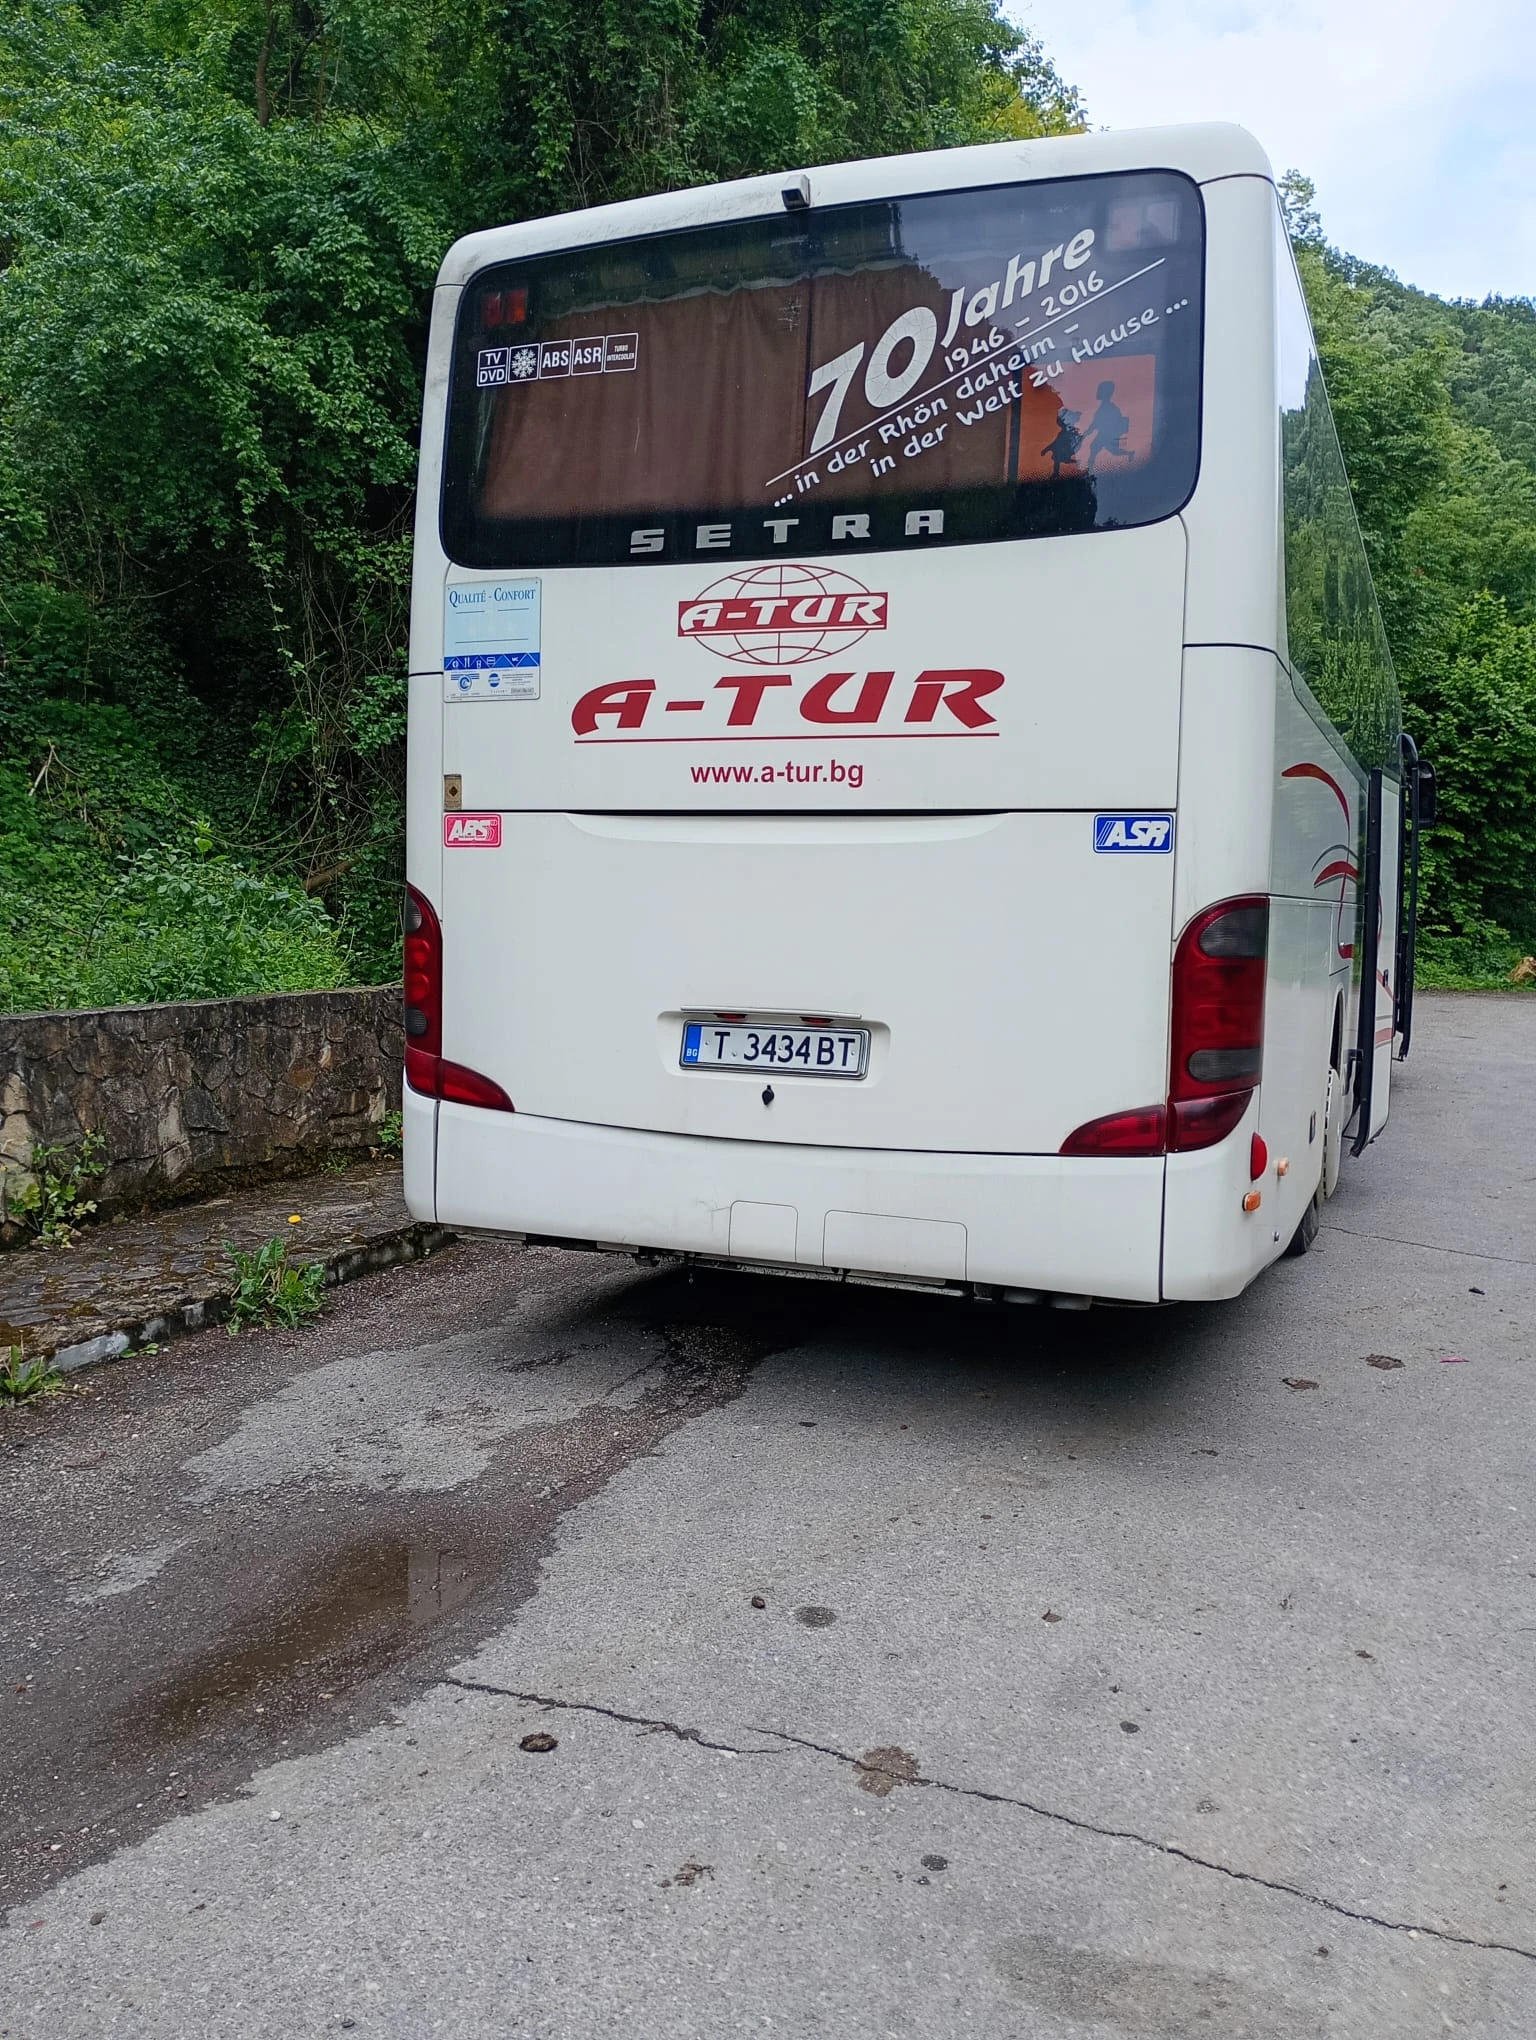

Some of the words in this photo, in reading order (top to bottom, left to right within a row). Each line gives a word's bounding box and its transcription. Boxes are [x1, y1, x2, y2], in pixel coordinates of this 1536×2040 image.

[943, 326, 1005, 373] 1946
[1040, 269, 1104, 317] 2016
[573, 347, 602, 365] ASR
[807, 305, 938, 454] 70
[940, 228, 1096, 349] Jahre
[485, 352, 502, 366] TV
[542, 350, 569, 368] ABS
[479, 368, 505, 384] DVD
[826, 439, 871, 473] der
[877, 397, 949, 445] Rhön
[955, 336, 1056, 400] daheim
[869, 454, 896, 478] in
[903, 422, 948, 458] der
[955, 379, 1024, 427] Welt
[1028, 359, 1065, 389] zu
[629, 508, 945, 554] SETRA
[679, 595, 886, 632] A-TUR
[571, 668, 1006, 736] A-TUR
[690, 758, 865, 789] www.a-tur.bg
[447, 818, 490, 842] ABS
[1103, 819, 1171, 848] ASR
[686, 1047, 698, 1057] BG
